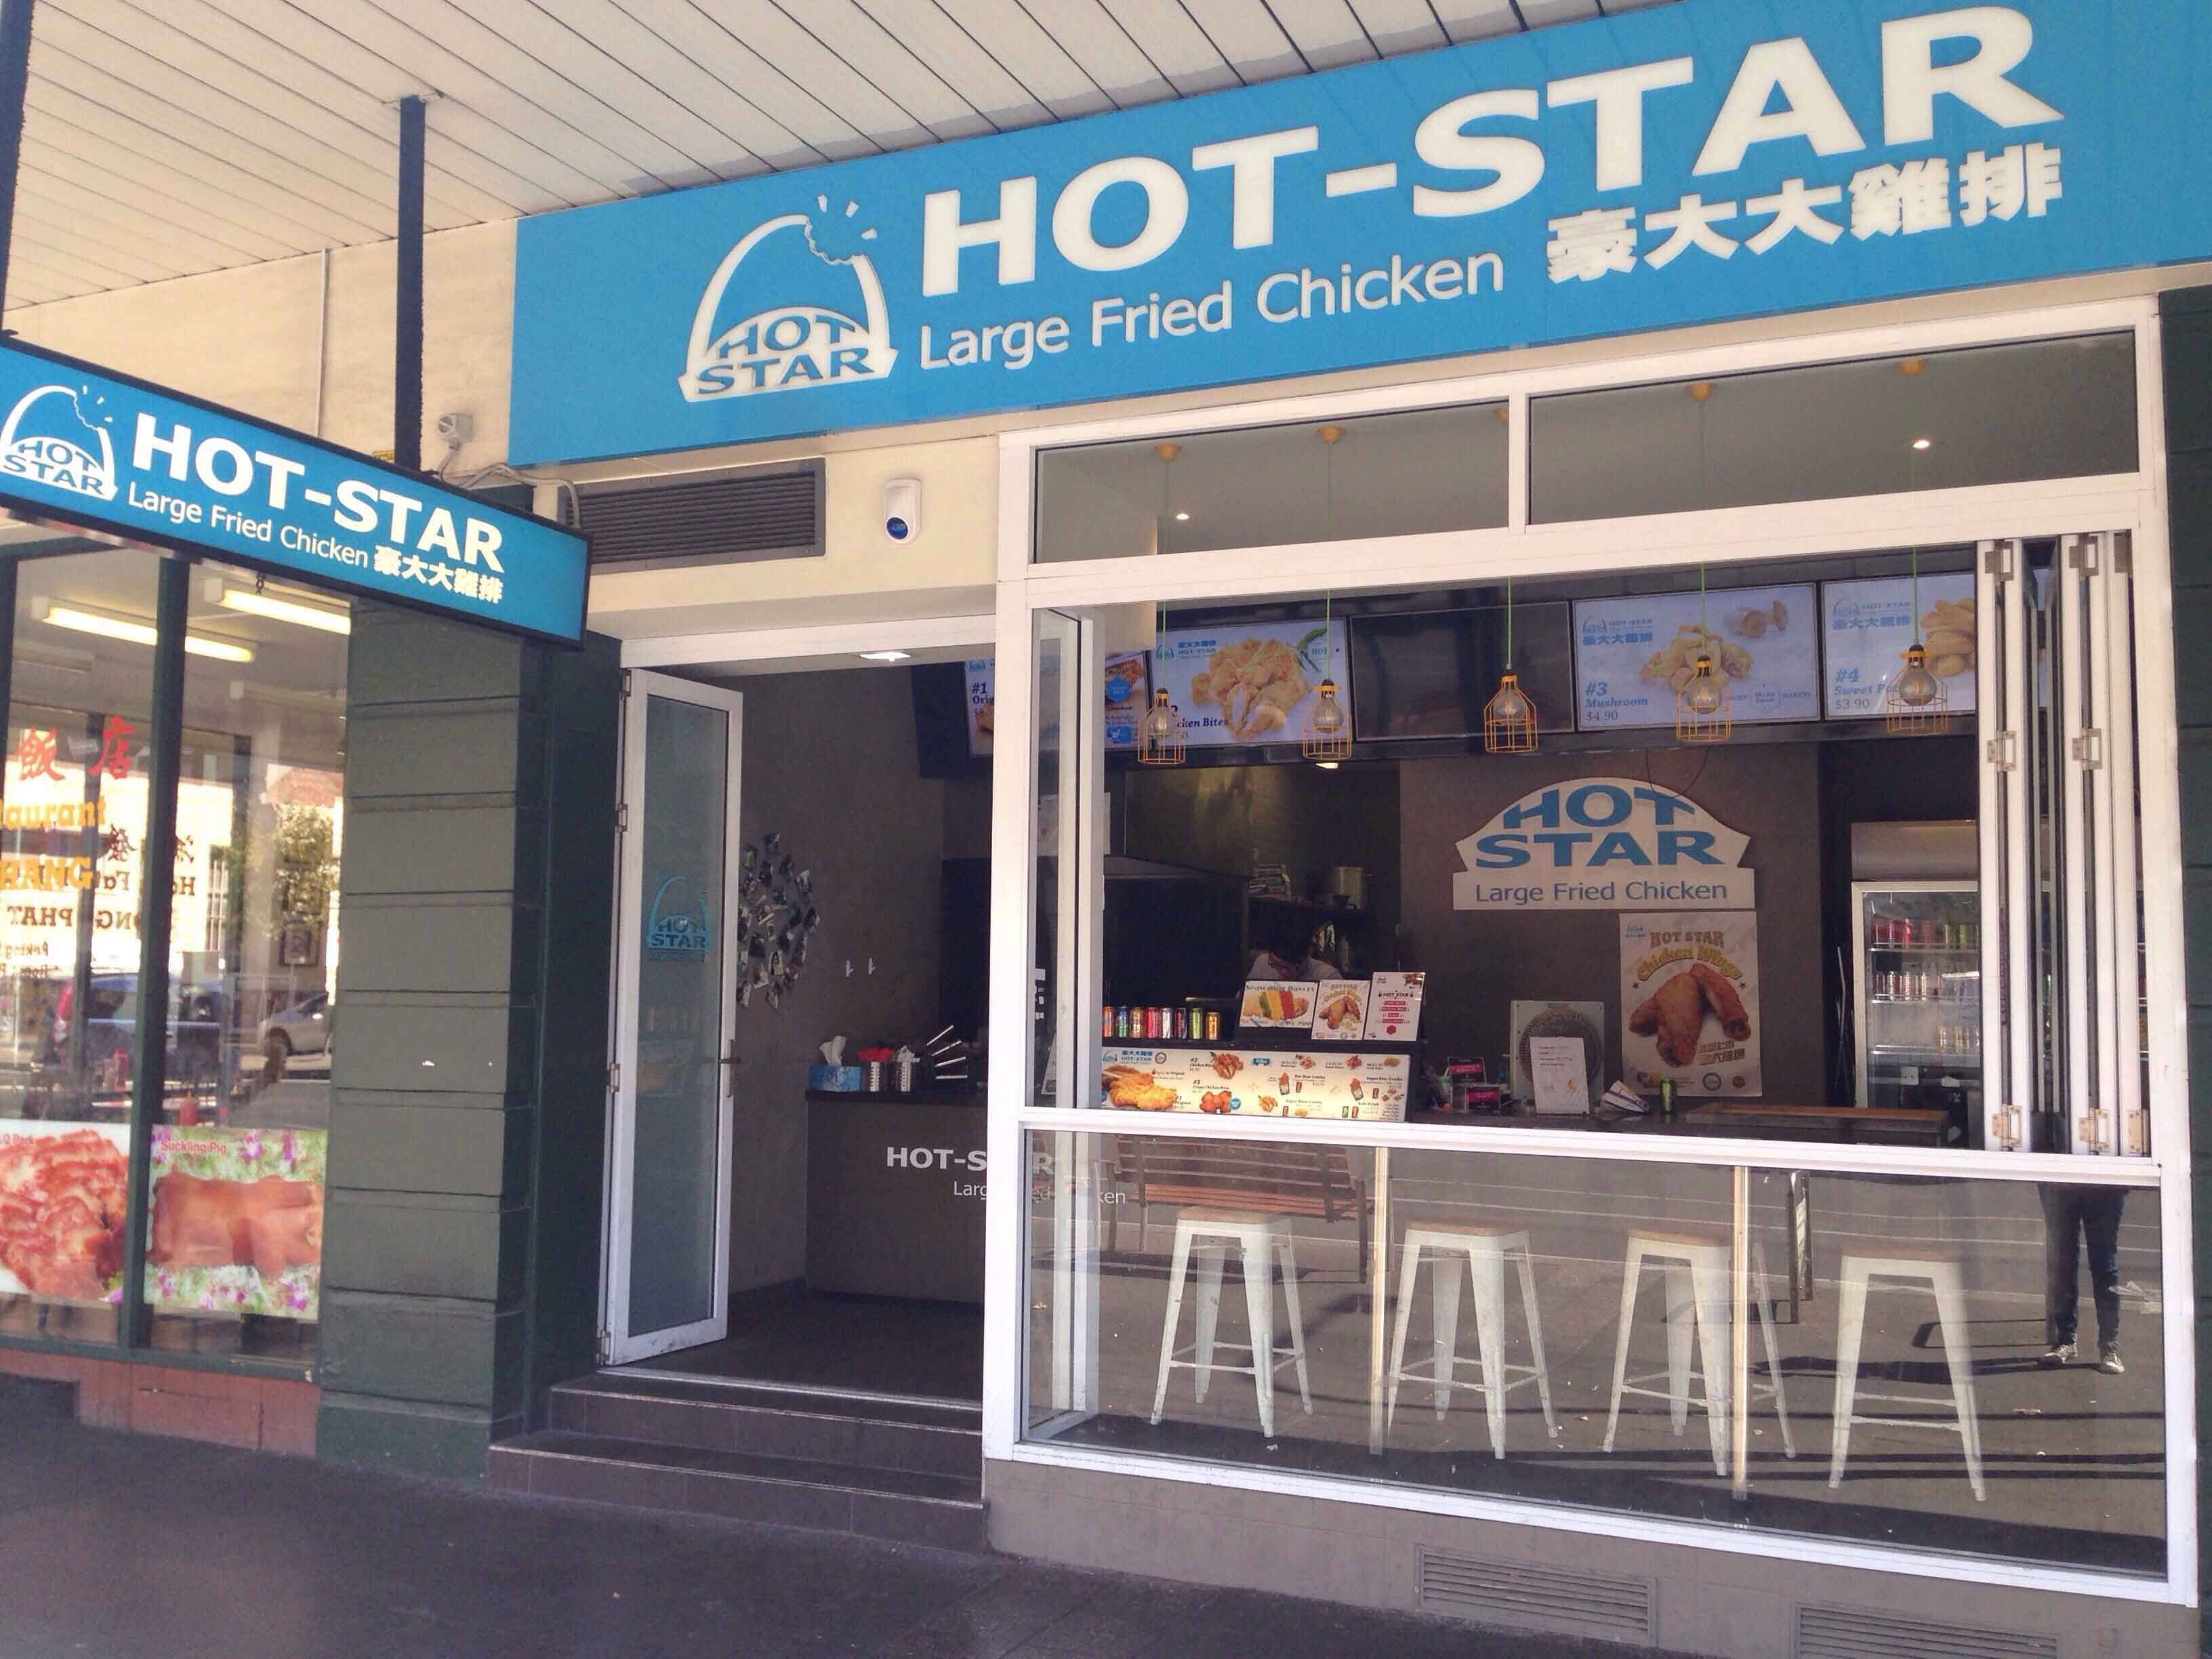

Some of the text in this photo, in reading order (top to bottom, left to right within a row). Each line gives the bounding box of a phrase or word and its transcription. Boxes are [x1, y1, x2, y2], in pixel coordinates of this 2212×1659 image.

[922, 5, 2064, 297] HOT-STAR
[1546, 143, 2063, 285] 豪大大雞排
[920, 249, 1504, 369] Large Fried Chicken
[718, 314, 857, 359] HOT
[697, 346, 874, 394] STAR
[18, 441, 98, 472] HOT
[3, 455, 105, 496] STAR
[133, 412, 505, 573] HOT-STAR
[129, 482, 369, 569] Large Fried Chicken
[1586, 681, 1607, 696] #3
[1834, 684, 1873, 695] Sweet
[1836, 666, 1860, 683] #4
[1586, 696, 1649, 708] Mushroom
[1176, 718, 1200, 728] cken
[0, 796, 106, 829] aurant
[1503, 784, 1694, 830] HOT
[1476, 831, 1726, 869] STAR
[1476, 882, 1727, 905] Large Fried Chicken
[651, 933, 705, 948] STAR
[1650, 930, 1725, 949] HOT STAR
[161, 1139, 207, 1154] Suckling
[954, 1181, 987, 1200] Larg
